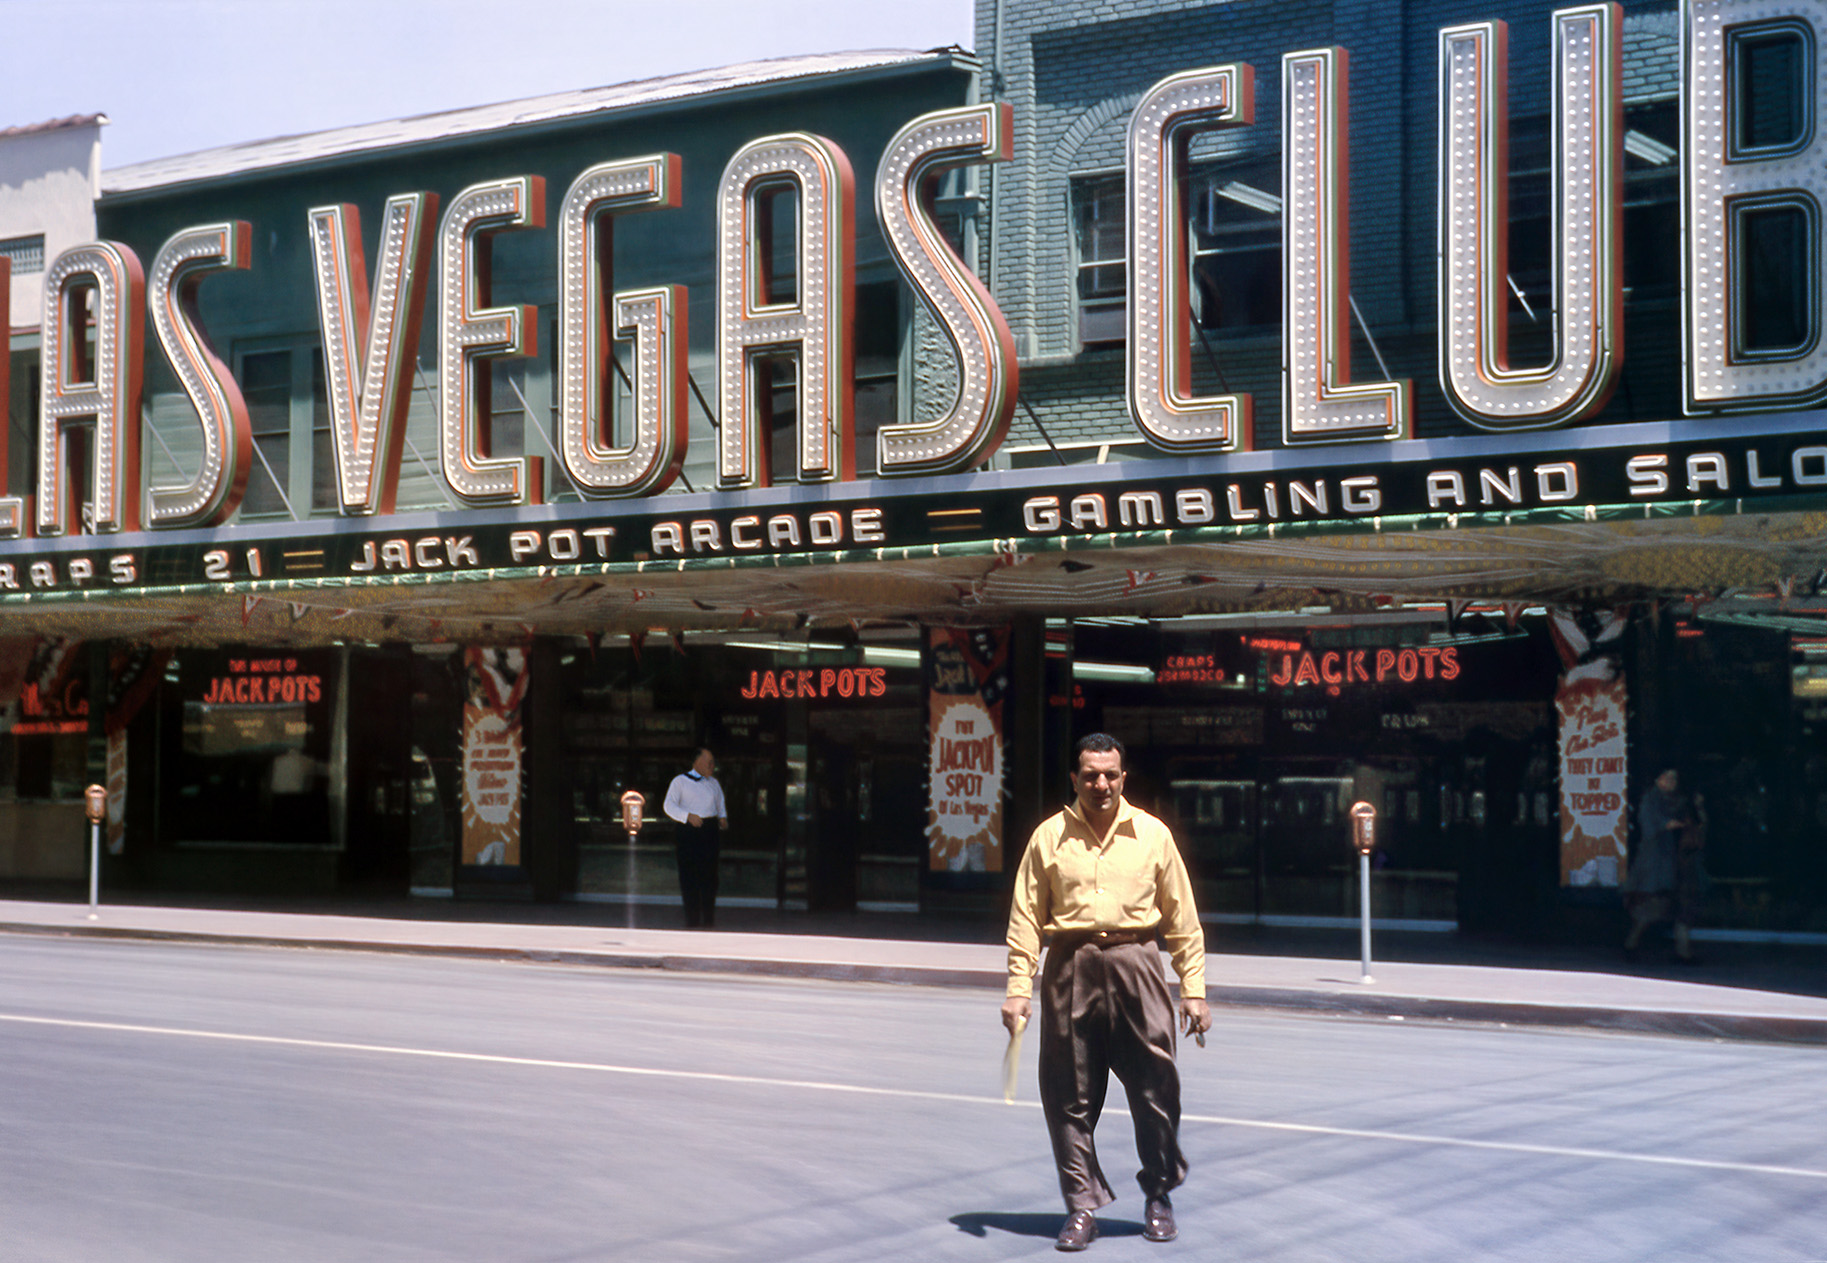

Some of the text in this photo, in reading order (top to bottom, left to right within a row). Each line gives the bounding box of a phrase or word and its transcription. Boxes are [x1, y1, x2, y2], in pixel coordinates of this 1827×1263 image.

[0, 0, 1827, 540] AS VEGAS CLUB
[203, 547, 262, 580] 21
[351, 534, 479, 572] JACK
[510, 526, 616, 563] POT
[651, 508, 886, 555] ARCADE
[1023, 474, 1382, 533] GAMBLING
[1427, 462, 1578, 508] AND
[1626, 446, 1827, 497] SALO
[1272, 647, 1460, 686] JACK POTS
[204, 675, 321, 703] JACK POTS
[741, 668, 886, 699] JACK POTS
[945, 774, 983, 797] SPOT
[1569, 792, 1620, 811] TOPPED
